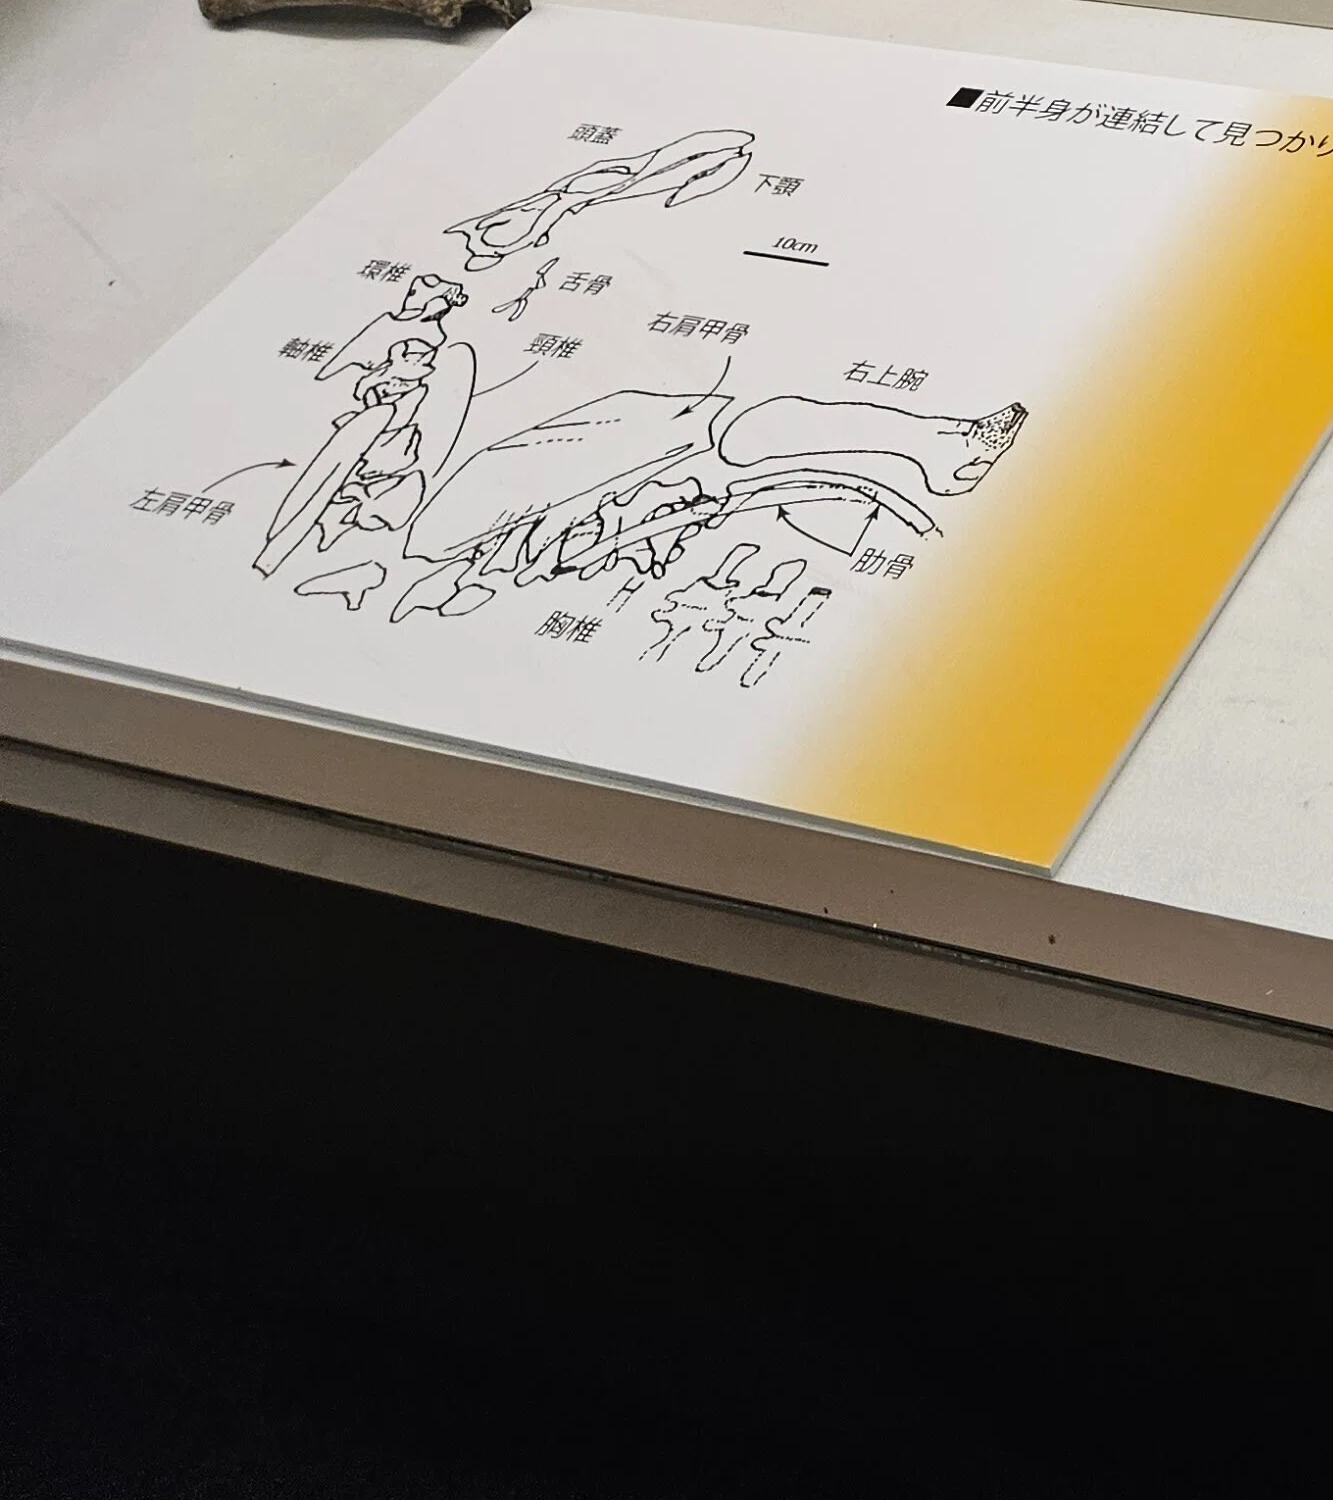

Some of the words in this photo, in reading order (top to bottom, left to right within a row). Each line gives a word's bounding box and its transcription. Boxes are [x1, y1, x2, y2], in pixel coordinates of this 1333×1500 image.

[566, 122, 622, 146] 頭蓋
[771, 235, 819, 255] 10cm
[356, 259, 412, 283] 環椎
[558, 271, 613, 296] 舌骨
[646, 310, 752, 345] 右肩甲骨
[843, 357, 929, 393] 右上腕
[128, 487, 236, 527] 左肩甲骨
[848, 547, 915, 581] 肋骨
[534, 610, 603, 644] 胸椎
